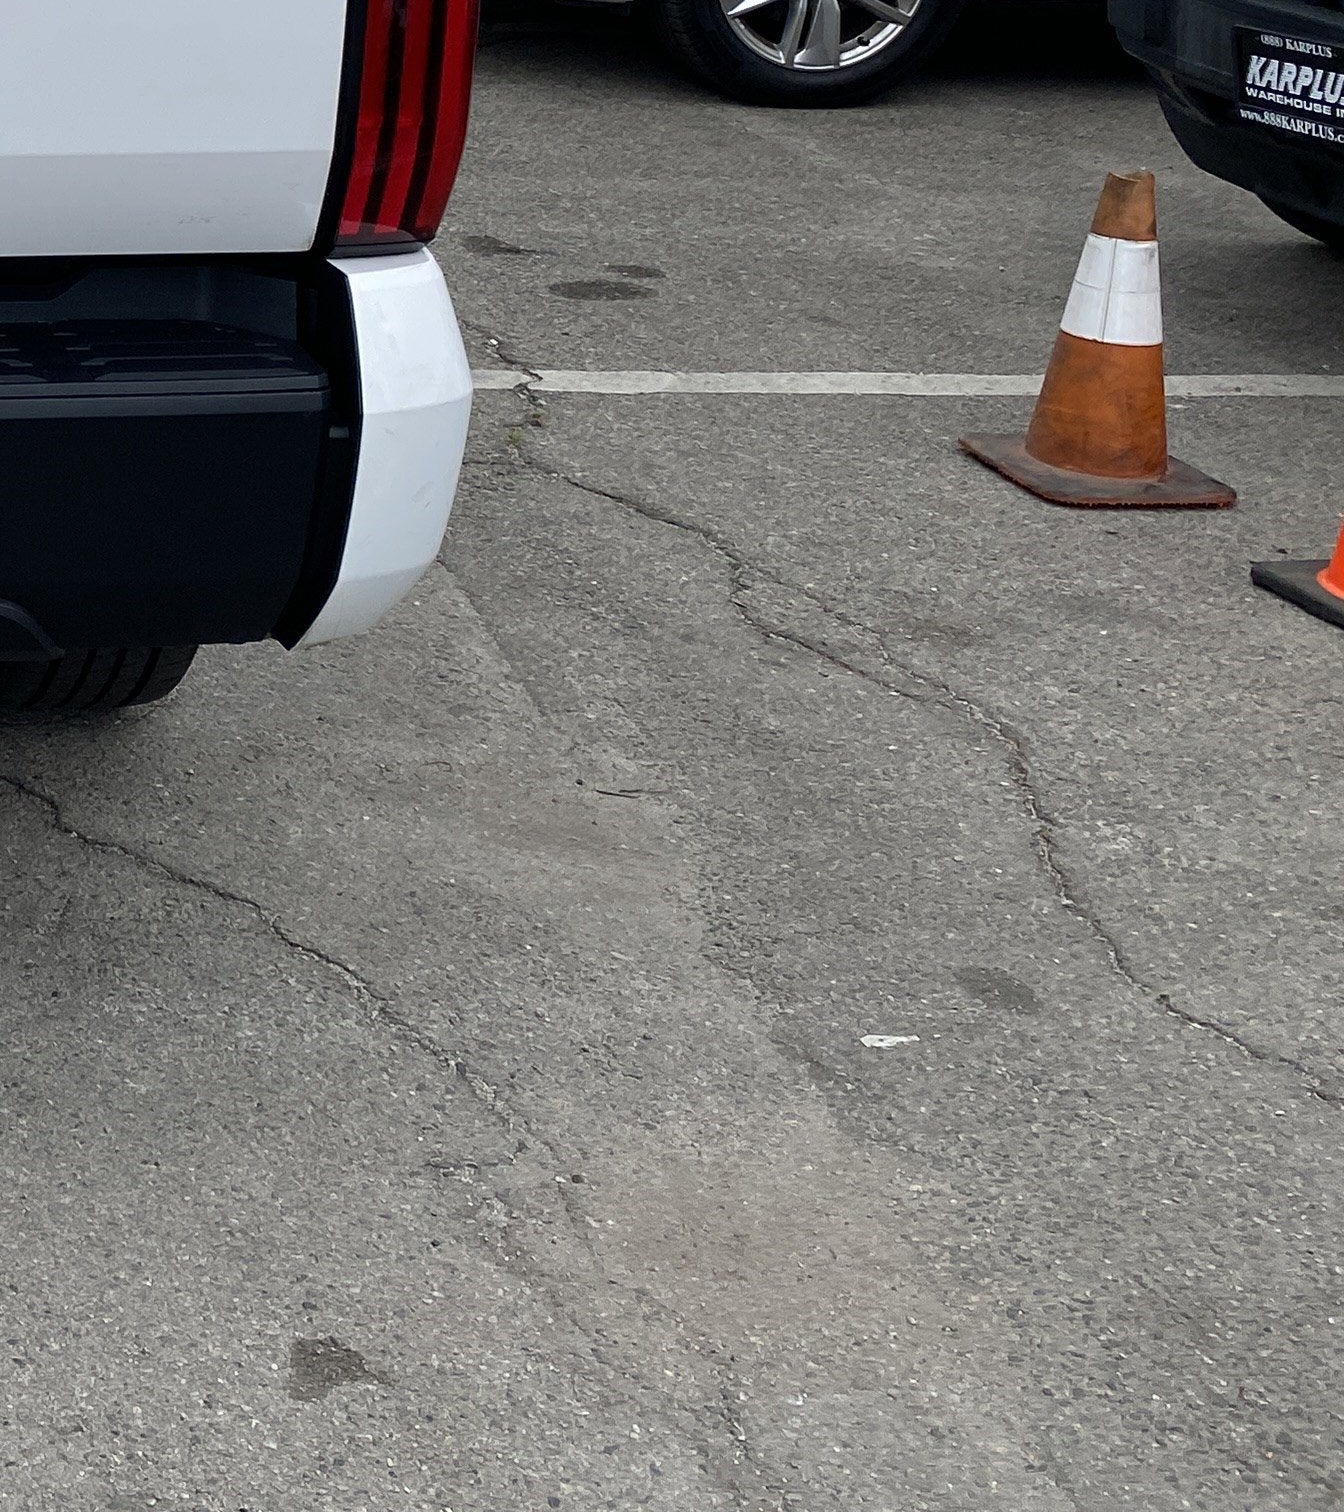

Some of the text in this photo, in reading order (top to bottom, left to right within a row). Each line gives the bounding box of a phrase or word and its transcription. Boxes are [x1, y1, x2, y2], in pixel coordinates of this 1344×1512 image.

[1285, 38, 1332, 58] KARPLUS
[1246, 55, 1344, 106] KARPLU
[1245, 86, 1332, 116] WAREHOUSE
